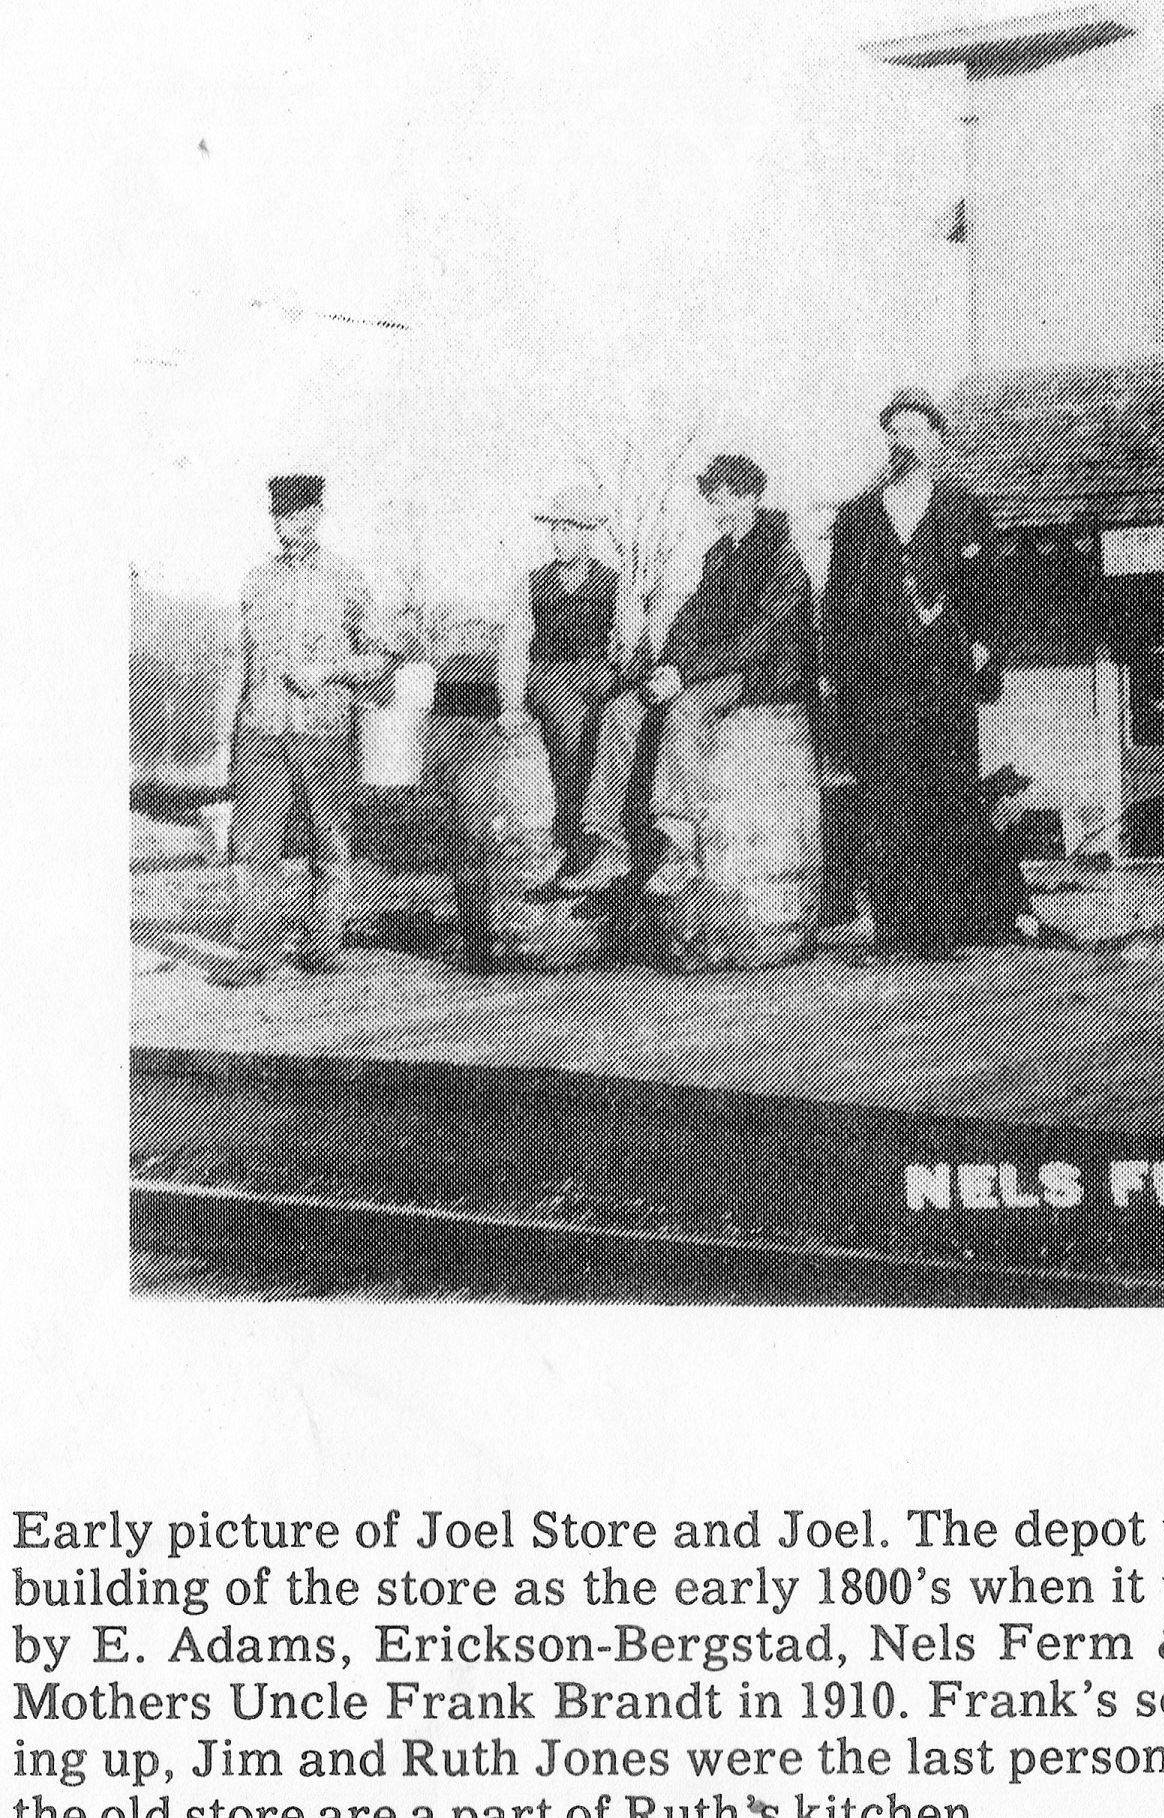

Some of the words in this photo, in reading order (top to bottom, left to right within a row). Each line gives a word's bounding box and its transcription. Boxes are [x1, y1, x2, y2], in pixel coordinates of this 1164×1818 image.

[12, 1509, 153, 1559] Early
[167, 1510, 340, 1559] picture
[355, 1508, 401, 1549] of
[416, 1509, 515, 1549] Joel
[532, 1509, 657, 1549] Store
[674, 1509, 761, 1549] and
[778, 1508, 889, 1549] Joel.
[906, 1508, 998, 1549] The
[1014, 1508, 1146, 1557] depot
[11, 1566, 210, 1616] building
[225, 1565, 272, 1606] of
[286, 1566, 360, 1607] the
[377, 1570, 497, 1607] store
[514, 1577, 565, 1606] as
[583, 1565, 657, 1606] the
[675, 1565, 800, 1615] early
[818, 1566, 951, 1606] 1800’s
[969, 1564, 1095, 1605] when
[1111, 1565, 1145, 1604] it
[11, 1623, 71, 1673] by
[92, 1625, 145, 1664] E.
[167, 1624, 351, 1670] Adams,
[374, 1623, 847, 1672] Erickson-Bergstad,
[869, 1622, 976, 1662] Nels
[998, 1622, 1134, 1662] Ferm
[13, 1680, 211, 1721] Mothers
[229, 1680, 368, 1721] Uncle
[386, 1680, 536, 1721] Frank
[553, 1680, 723, 1720] Brandt
[739, 1681, 783, 1719] in
[801, 1680, 908, 1720] 1910.
[928, 1678, 1117, 1719] Frank’s
[13, 1738, 88, 1788] ing
[102, 1749, 174, 1787] up,
[191, 1738, 283, 1778] Jim
[299, 1737, 387, 1778] and
[402, 1737, 520, 1777] Ruth
[535, 1738, 670, 1777] Jones
[686, 1748, 803, 1777] were
[817, 1735, 891, 1776] the
[907, 1736, 995, 1776] last
